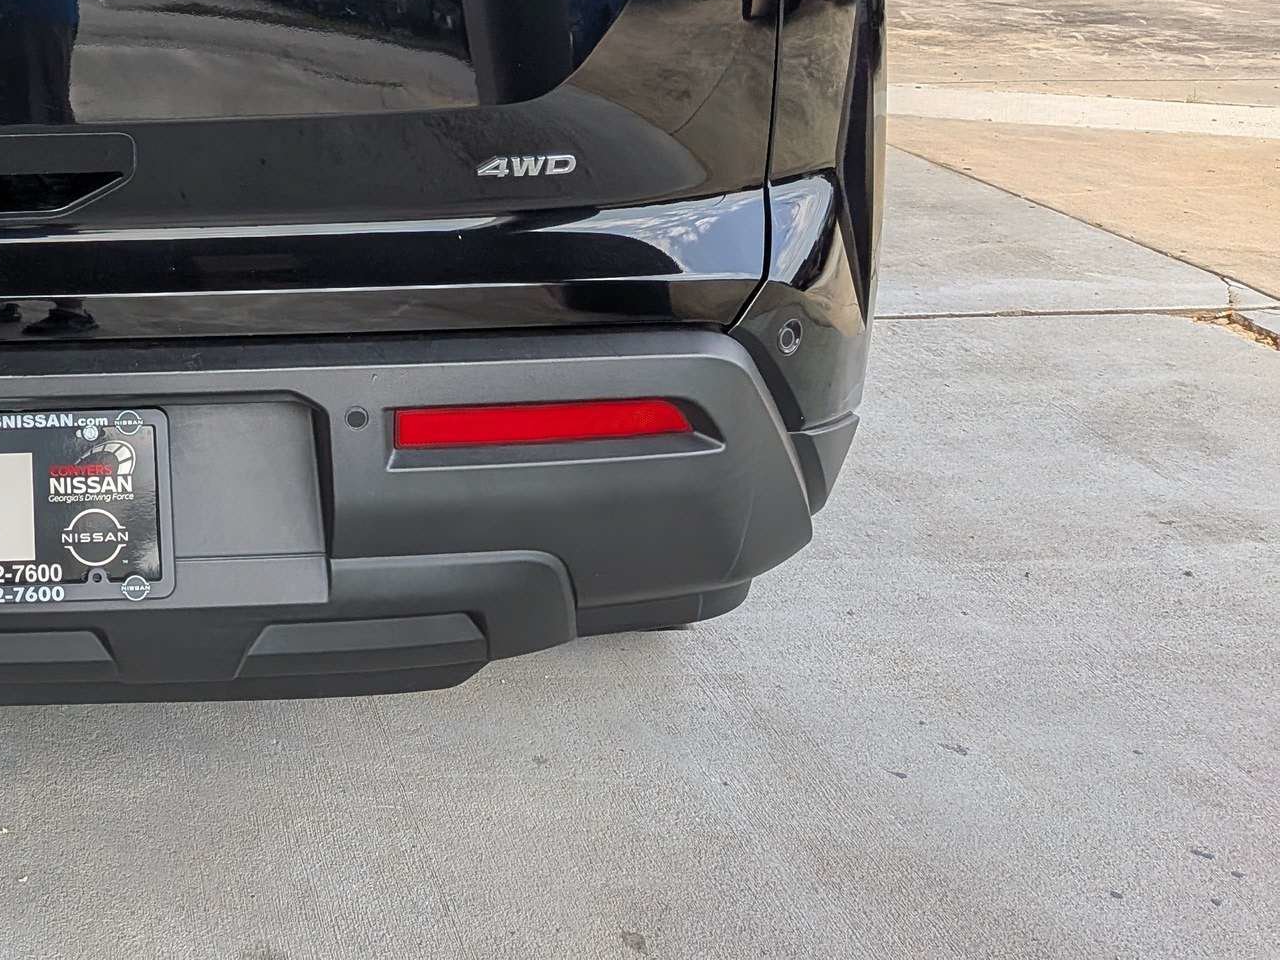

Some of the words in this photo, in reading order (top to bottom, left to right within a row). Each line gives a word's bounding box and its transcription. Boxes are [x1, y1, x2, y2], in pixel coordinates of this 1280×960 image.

[477, 154, 577, 178] 4WD
[48, 463, 113, 477] CONYERS
[49, 475, 132, 494] NISSAN
[48, 494, 84, 503] Georgia's
[84, 493, 110, 502] Driving
[61, 531, 129, 543] NISSAN
